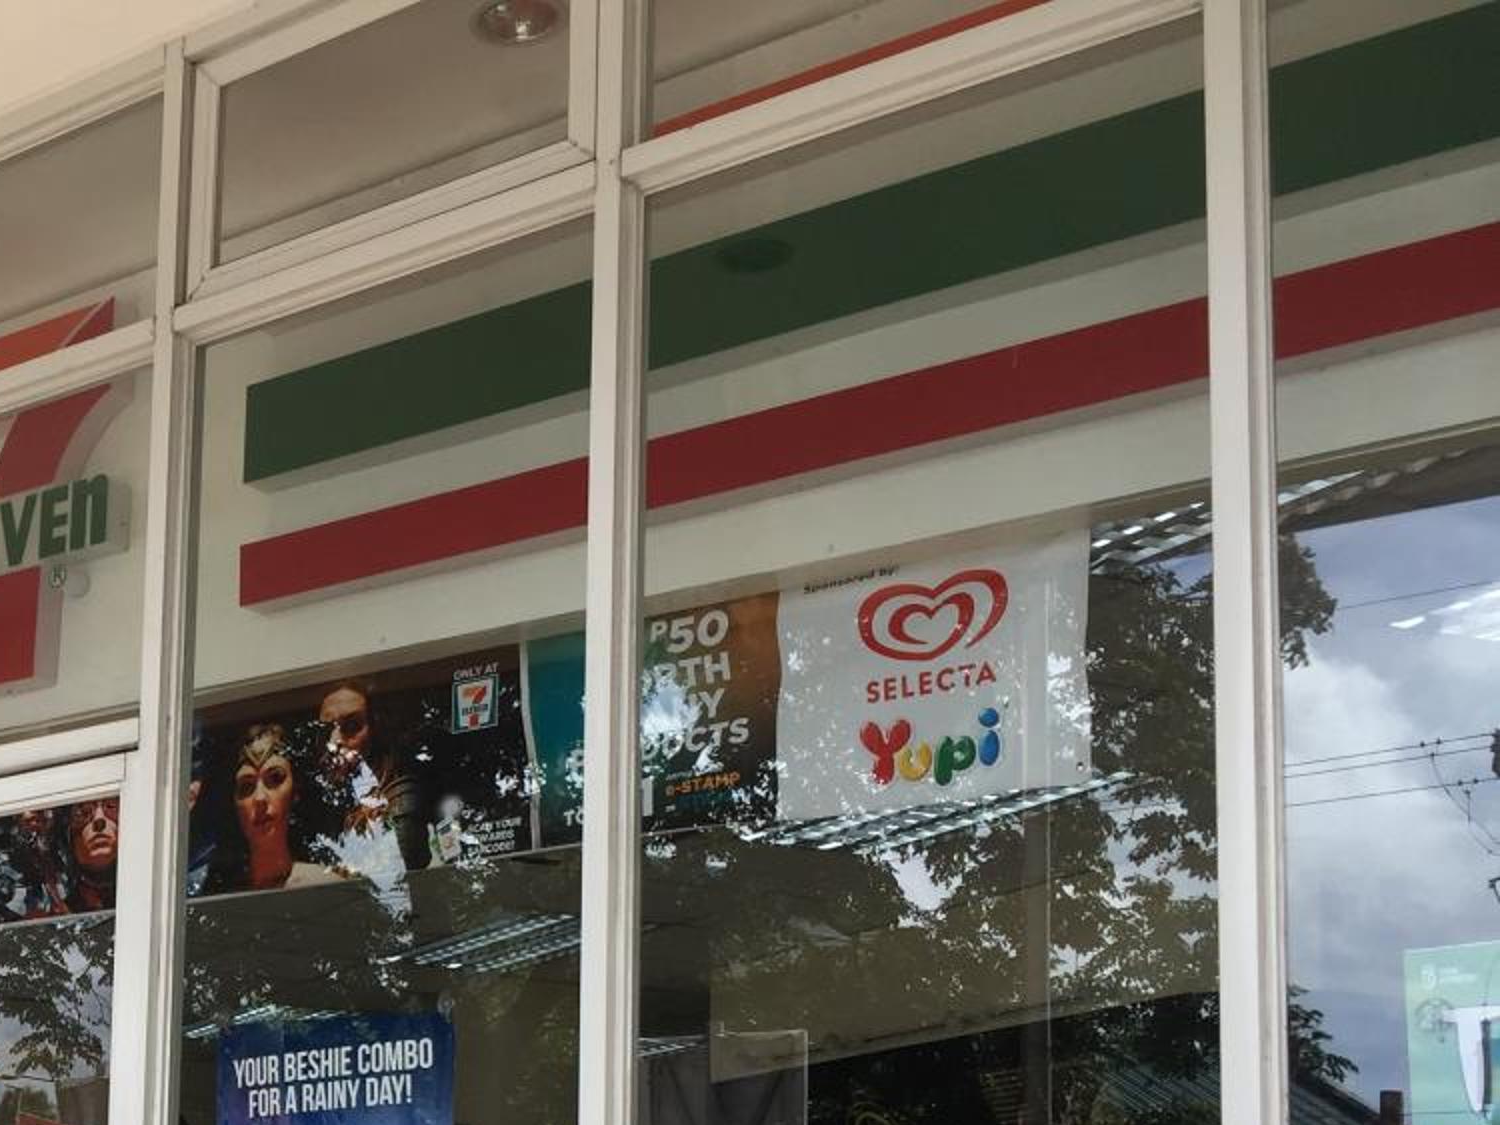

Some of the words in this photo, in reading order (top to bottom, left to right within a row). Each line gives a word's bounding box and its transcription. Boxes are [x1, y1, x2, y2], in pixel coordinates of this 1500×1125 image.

[453, 665, 481, 681] ONLY
[484, 662, 499, 674] AT
[866, 660, 997, 704] SELECTA
[859, 707, 1000, 786] Yupi
[233, 1054, 280, 1089] YOUR
[285, 1046, 353, 1083] BESHIE
[357, 1037, 434, 1075] COMBO
[248, 1088, 281, 1119] FOR
[285, 1086, 298, 1115] A
[302, 1078, 360, 1112] RAINY
[366, 1073, 413, 1108] DAY!
